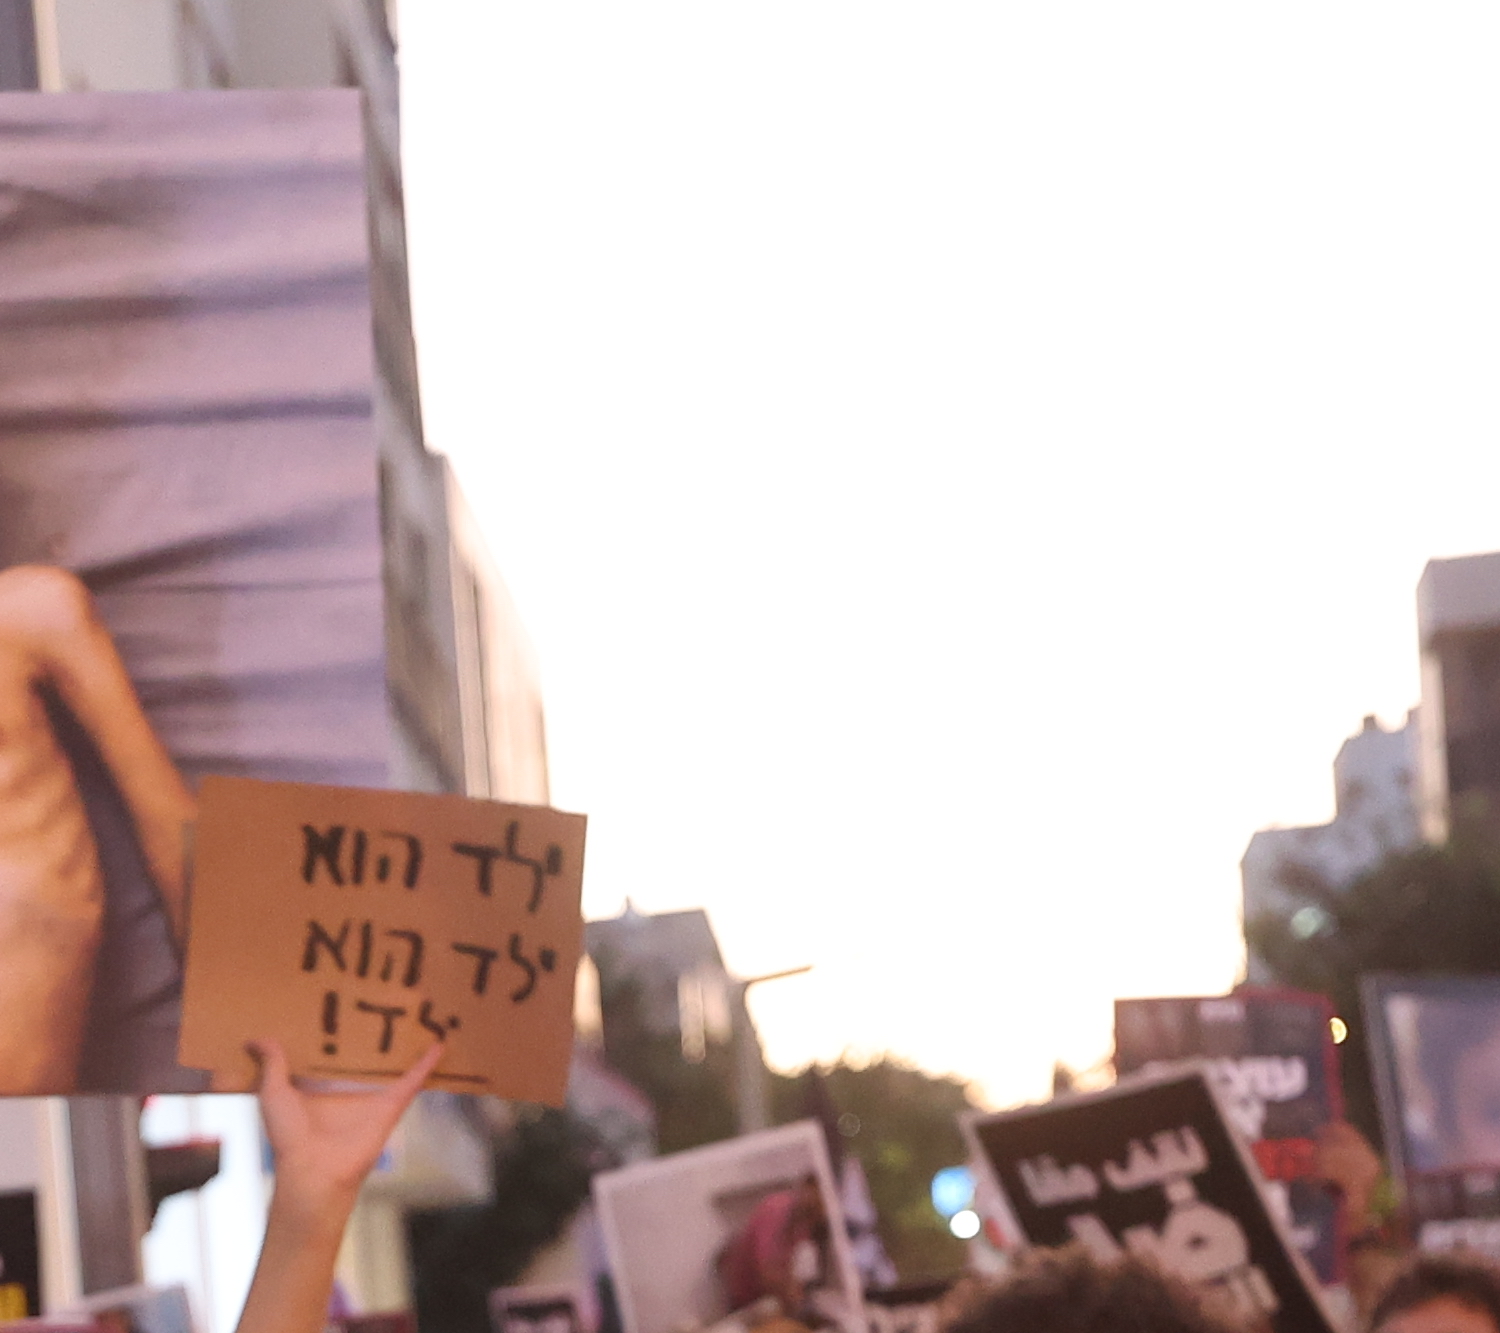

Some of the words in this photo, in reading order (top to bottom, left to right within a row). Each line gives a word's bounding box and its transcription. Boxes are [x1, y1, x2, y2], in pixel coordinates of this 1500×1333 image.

[301, 823, 425, 890] הוא
[451, 821, 564, 912] ילד
[301, 918, 426, 988] הוא
[451, 932, 558, 1003] ילד
